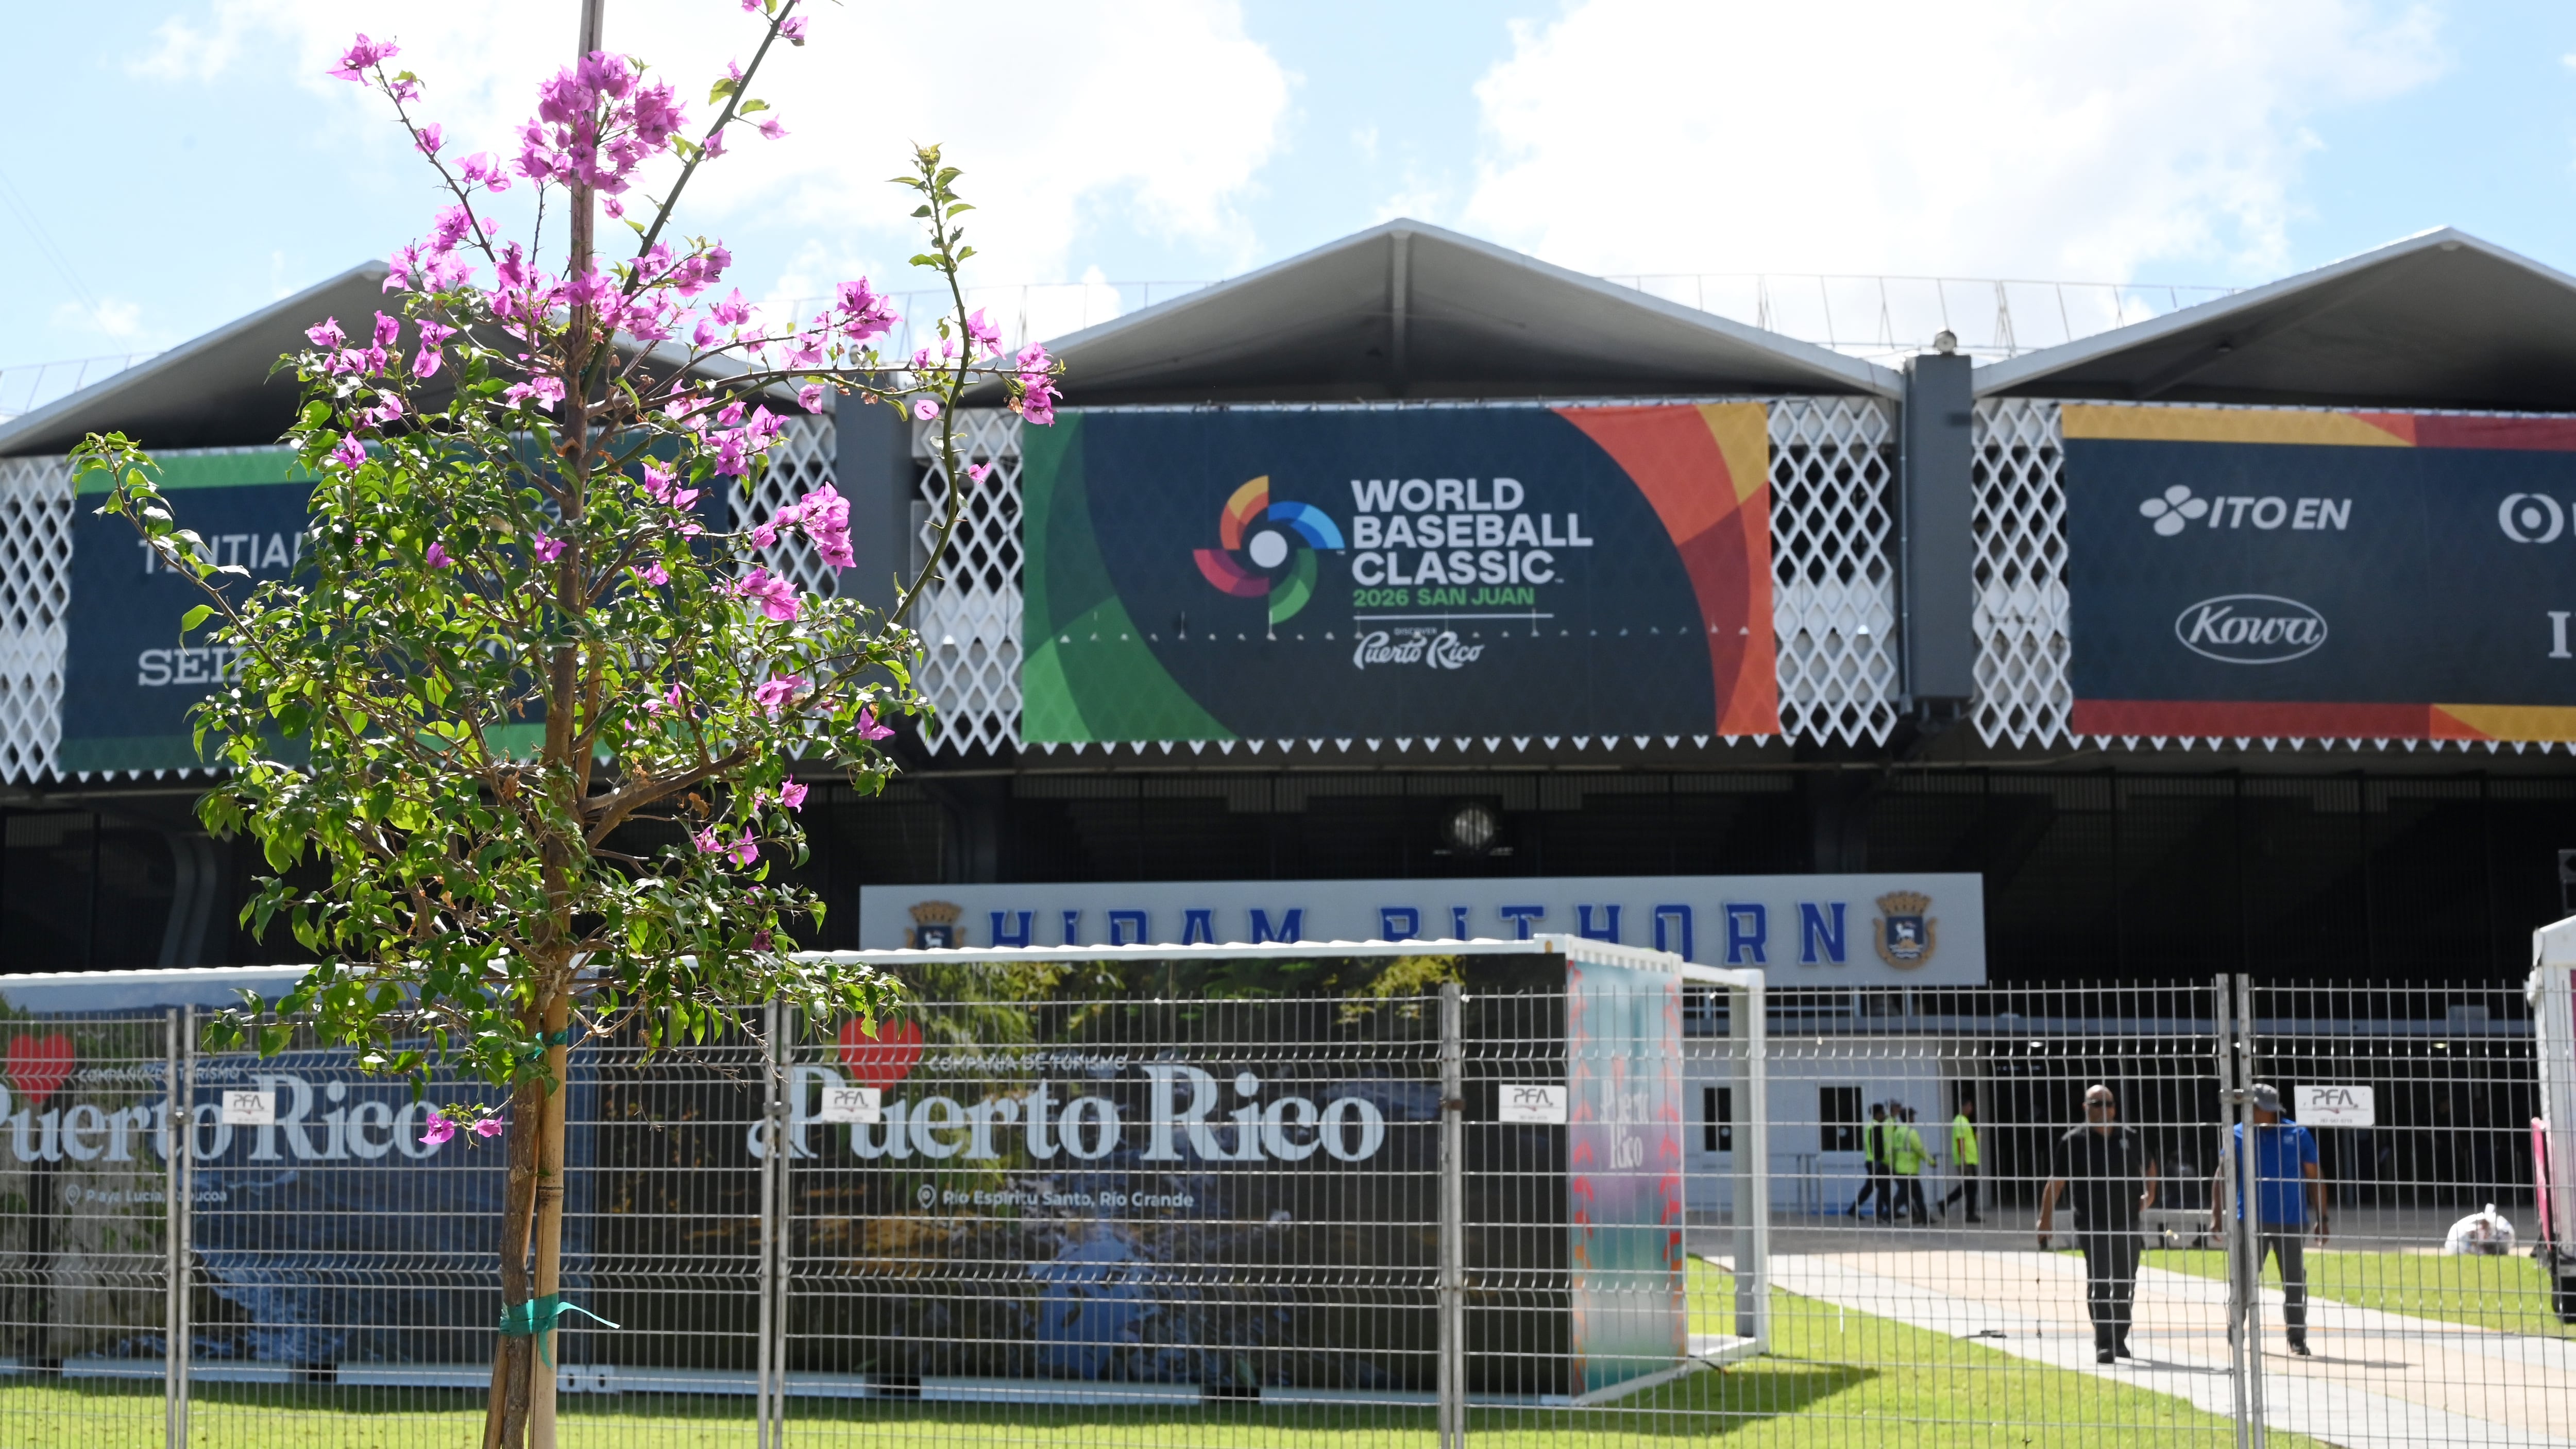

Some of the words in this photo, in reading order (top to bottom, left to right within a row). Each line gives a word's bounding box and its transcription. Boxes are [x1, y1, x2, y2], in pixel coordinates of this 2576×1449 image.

[1351, 478, 1524, 513] WORLD
[1352, 513, 1593, 549] BASEBALL
[2208, 496, 2286, 529] ITO
[2292, 498, 2352, 531] EN
[1351, 550, 1555, 586] CLASSIC
[1353, 588, 1409, 607] 2026
[1417, 588, 1467, 606] SAN
[1471, 587, 1535, 606] JUAN
[2188, 605, 2321, 644] Kowa
[1353, 631, 1428, 670] Puerto
[1426, 631, 1485, 670] Rico
[1023, 1052, 1046, 1071] DE
[1052, 1055, 1127, 1071] TURISMO
[748, 1066, 1122, 1161] Puerto
[1141, 1064, 1385, 1162] Rico
[834, 1090, 865, 1104] PFA
[1514, 1088, 1549, 1103] PFA
[2312, 1088, 2354, 1105] PFA
[247, 1074, 442, 1161] Rico
[1042, 1190, 1096, 1208] Santo,
[1099, 1190, 1128, 1206] Río
[1131, 1191, 1195, 1207] Grande
